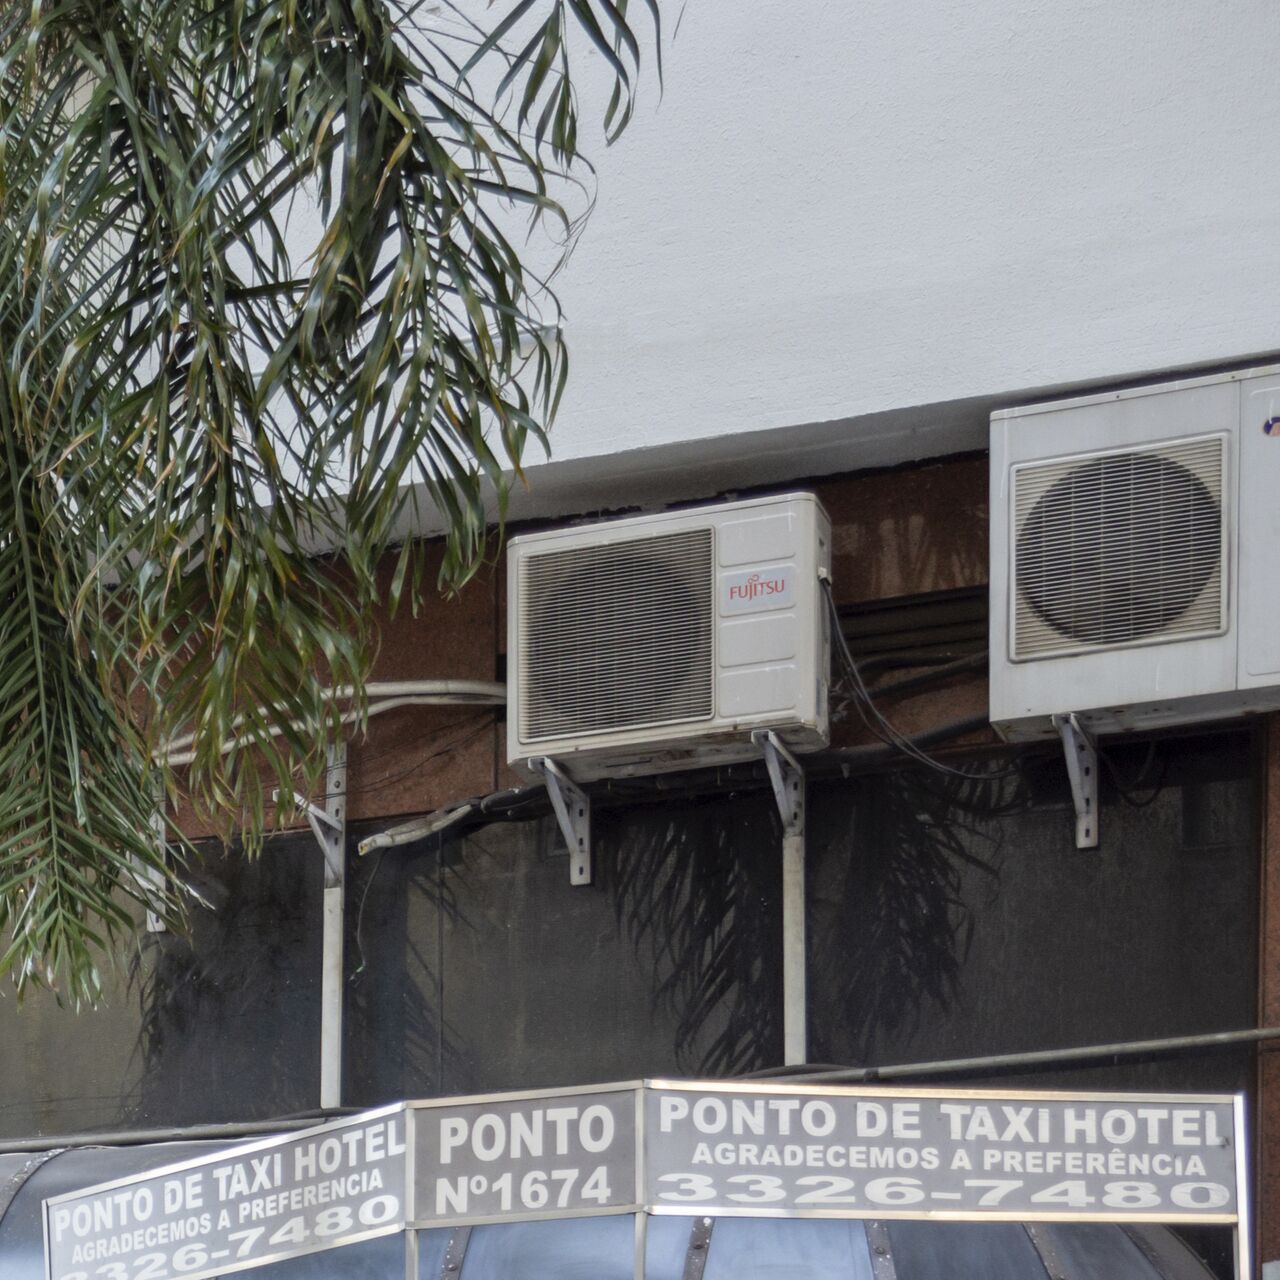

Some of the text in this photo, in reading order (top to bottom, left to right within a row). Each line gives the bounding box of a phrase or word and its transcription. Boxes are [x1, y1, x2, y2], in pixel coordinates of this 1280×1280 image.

[730, 579, 785, 600] FUJITSU
[440, 1104, 614, 1164] PONTO
[660, 1096, 1225, 1146] PONTO DE TAXI HOTEL
[55, 1120, 406, 1242] PONTO DE TAXI HOTEL
[692, 1142, 940, 1170] AGRADECEMOS
[951, 1149, 972, 1170] A
[72, 1168, 383, 1264] AGRADECEMOS A PREFERENCIA
[658, 1173, 1231, 1209] 3326-7480
